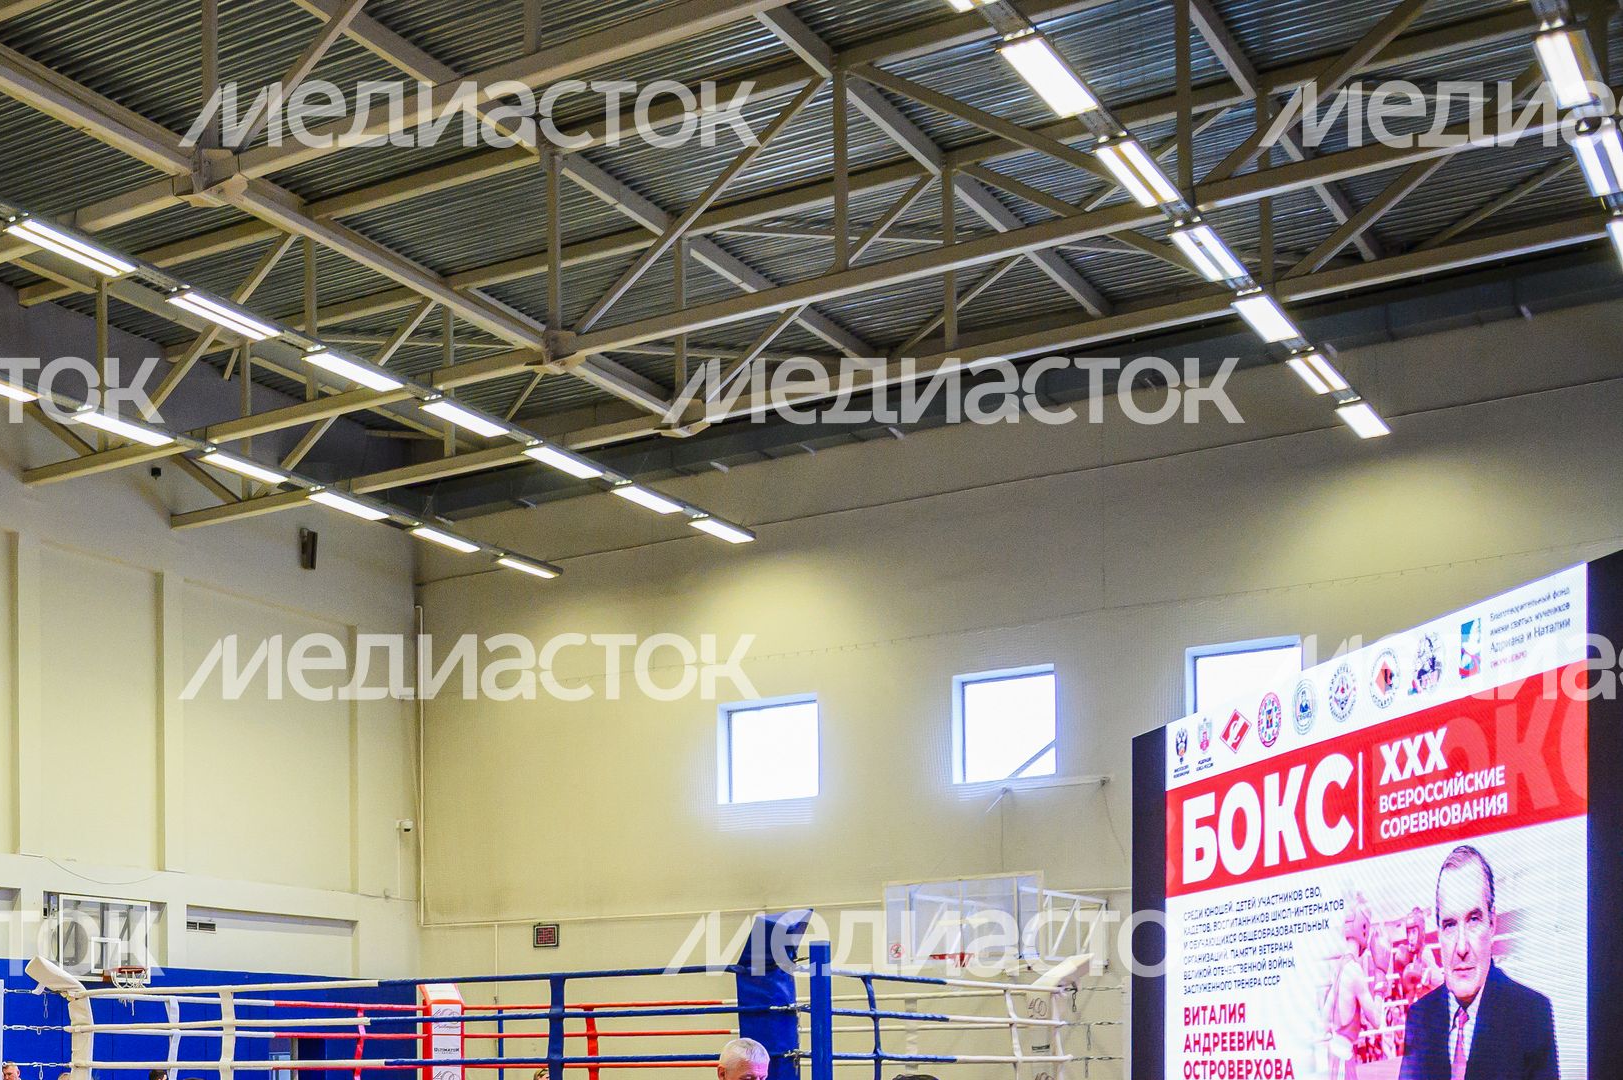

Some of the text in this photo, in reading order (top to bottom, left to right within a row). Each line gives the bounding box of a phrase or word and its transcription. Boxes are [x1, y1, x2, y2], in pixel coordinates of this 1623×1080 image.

[1534, 617, 1571, 638] Наталии
[1379, 765, 1506, 814] ВСЕРОССИЙСКИЕ
[1182, 753, 1354, 884] БОКС
[1380, 792, 1508, 839] СОРЕВНОВАНИЯ
[1183, 909, 1203, 921] СРЕДИ
[1258, 889, 1303, 908] УЧАСТНИКОВ
[1271, 898, 1345, 921] ШКОЛ-ИНТЕРНАТОВ
[1238, 918, 1330, 942] ОБЩЕОБРАЗОВАТЕЛЬНЫХ
[1230, 946, 1257, 959] ПАМЯТИ
[1258, 941, 1294, 956] ВЕТЕРАНА
[1183, 965, 1212, 980] ВЕЛИКОЙ
[1213, 958, 1267, 977] ОТЕЧЕСТВЕННОЙ
[1183, 974, 1281, 995] ЗАСЛУЖЕННОГО ТРЕНЕРА СССР
[1183, 1002, 1246, 1027] ВИТАЛИЯ
[1183, 1029, 1277, 1056] АНДРЕЕВИЧА
[1183, 1058, 1295, 1080] ОСТРОВЕРХОВА
